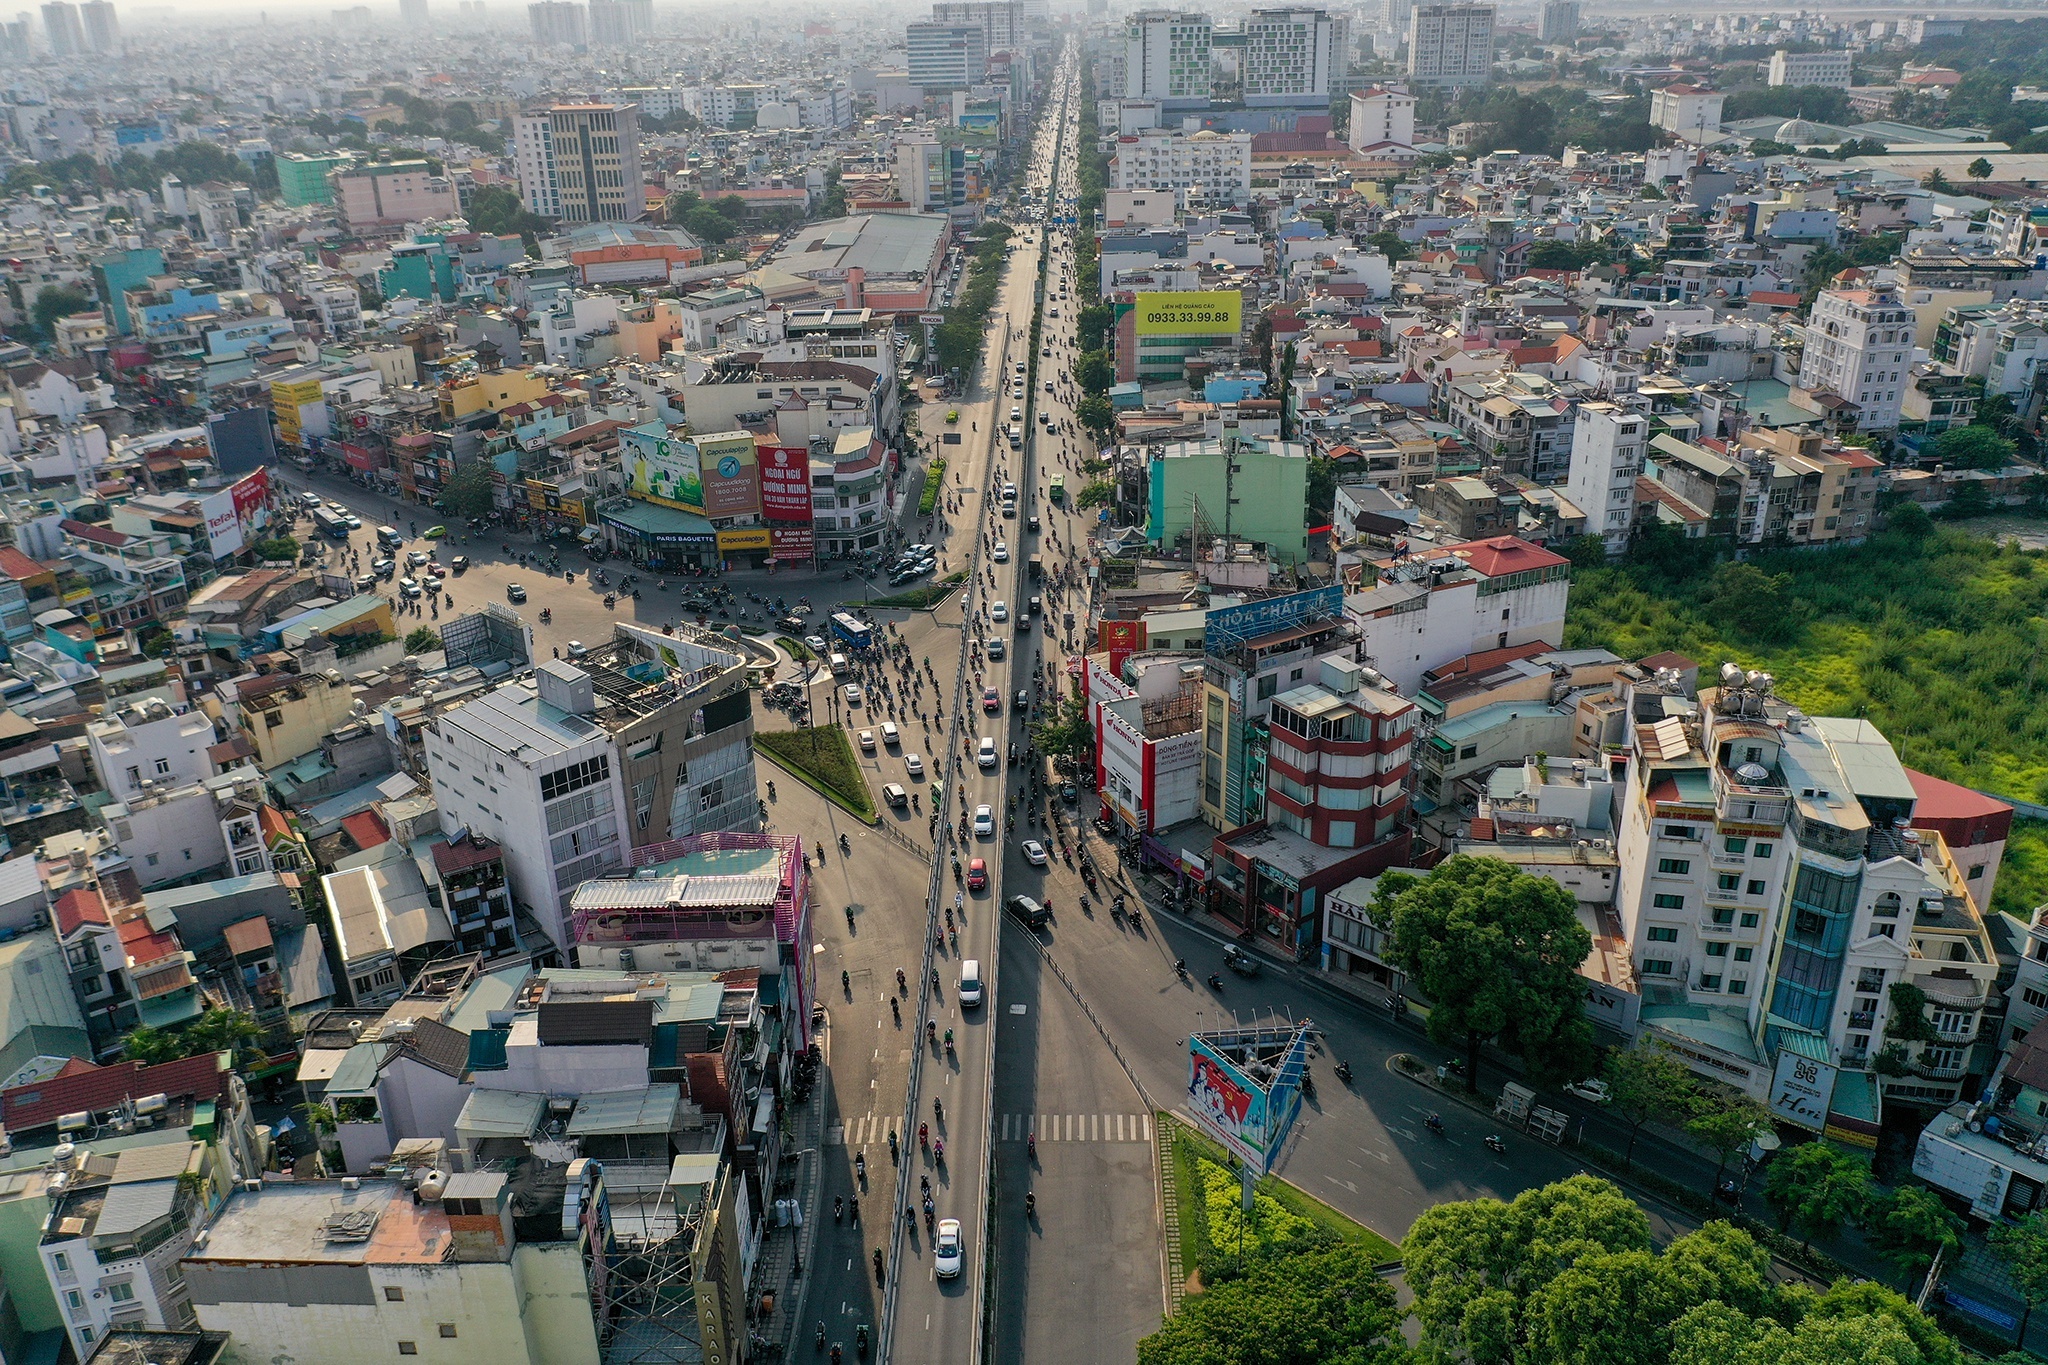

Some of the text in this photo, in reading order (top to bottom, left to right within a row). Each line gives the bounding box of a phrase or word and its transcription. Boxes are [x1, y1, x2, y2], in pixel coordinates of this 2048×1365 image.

[1148, 312, 1228, 322] 0933.33.99.88
[706, 446, 748, 456] Capcuulaptop
[764, 467, 801, 480] NGOẠI NGỮ
[763, 481, 807, 494] DƯƠNG MINH
[208, 510, 235, 528] Tefal
[720, 536, 766, 544] Capcuulaptop
[1220, 598, 1300, 627] HÒA PHÁT
[1100, 676, 1122, 696] HONDA
[1112, 724, 1137, 748] HONDA
[1331, 901, 1364, 922] HẢI
